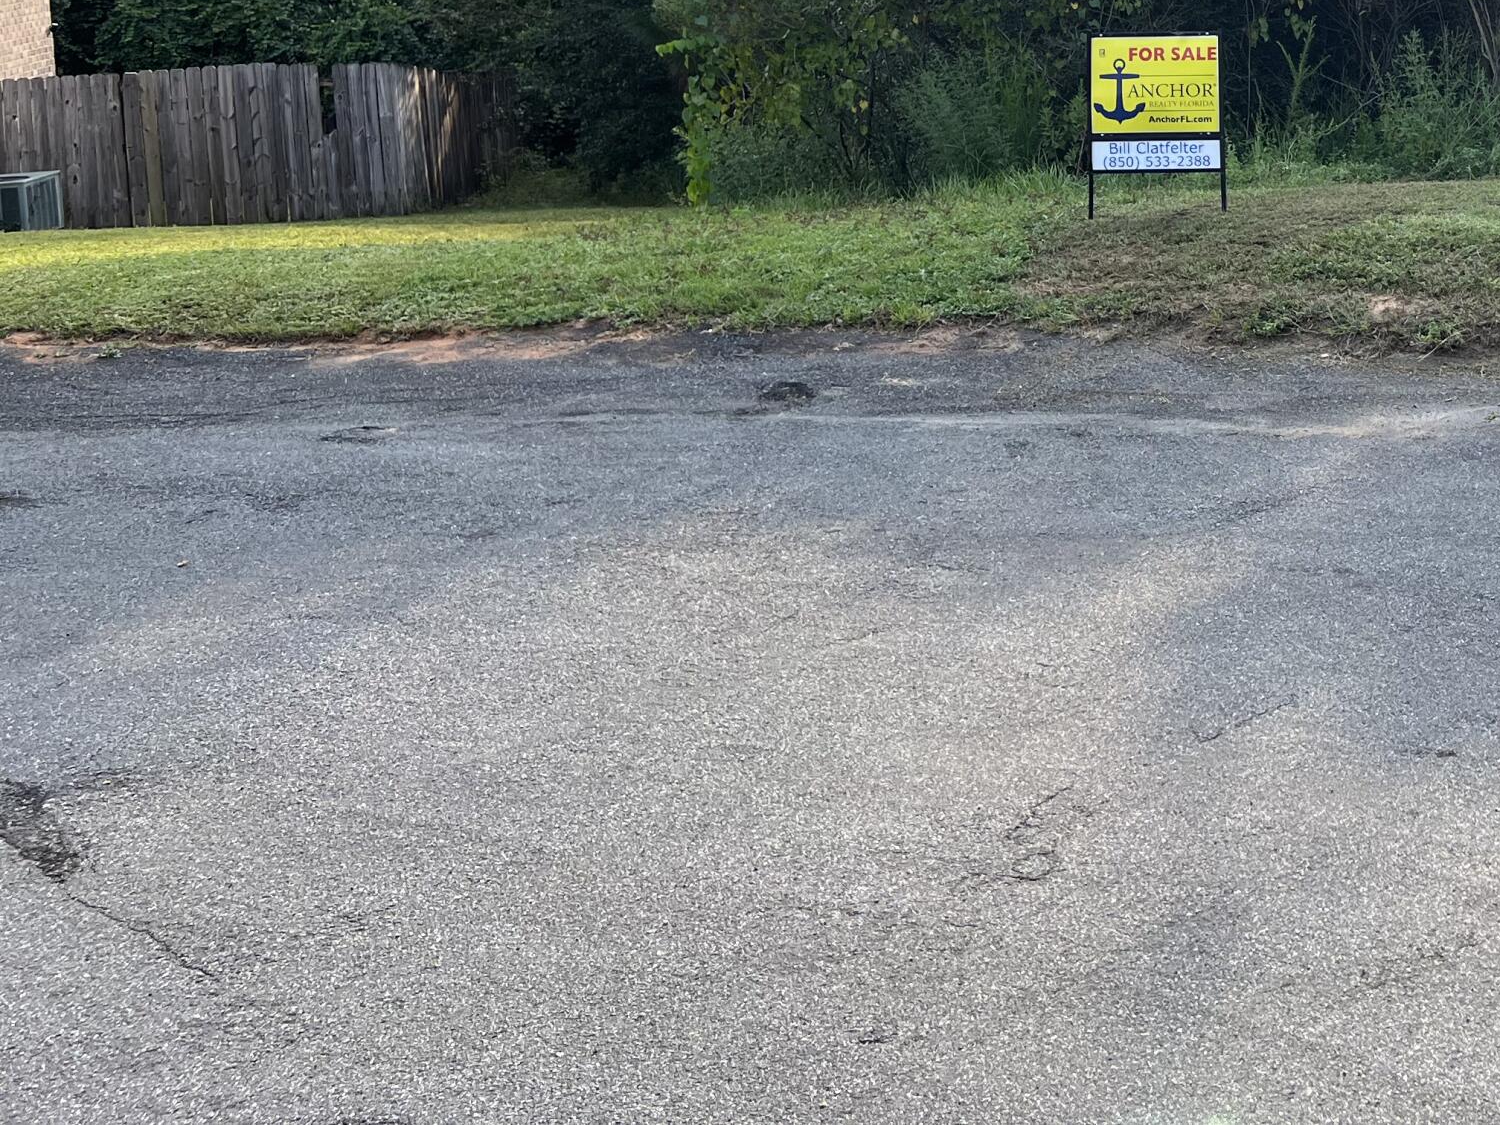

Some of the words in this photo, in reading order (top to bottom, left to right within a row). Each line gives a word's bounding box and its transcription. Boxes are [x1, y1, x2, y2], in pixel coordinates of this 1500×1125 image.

[1128, 47, 1165, 62] FOR
[1171, 46, 1217, 61] SALE
[1128, 83, 1215, 98] ANCHOR
[1109, 143, 1130, 154] Bill
[1136, 142, 1204, 154] Clatfelter
[1103, 157, 1140, 170] (850)
[1145, 155, 1211, 167] 533-2388
